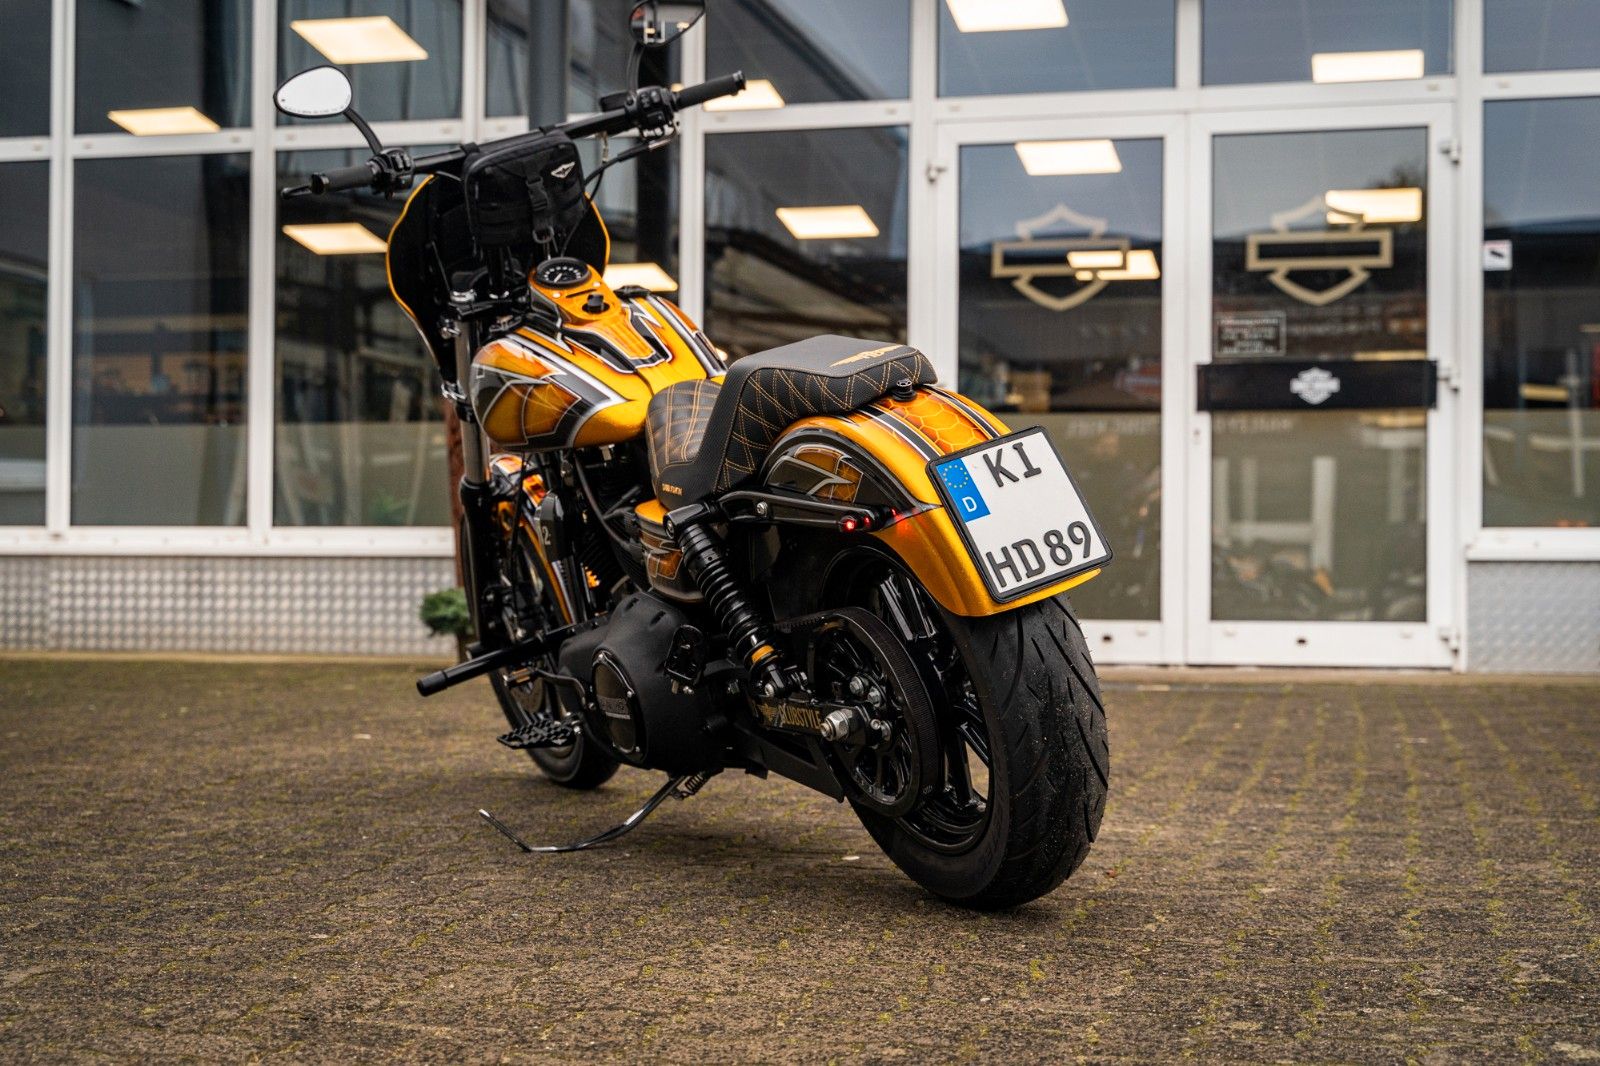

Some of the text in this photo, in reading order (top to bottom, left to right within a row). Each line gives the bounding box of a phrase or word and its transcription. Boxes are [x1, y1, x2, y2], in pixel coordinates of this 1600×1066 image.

[983, 442, 1042, 488] KI
[962, 496, 977, 513] D
[986, 521, 1091, 588] HD89
